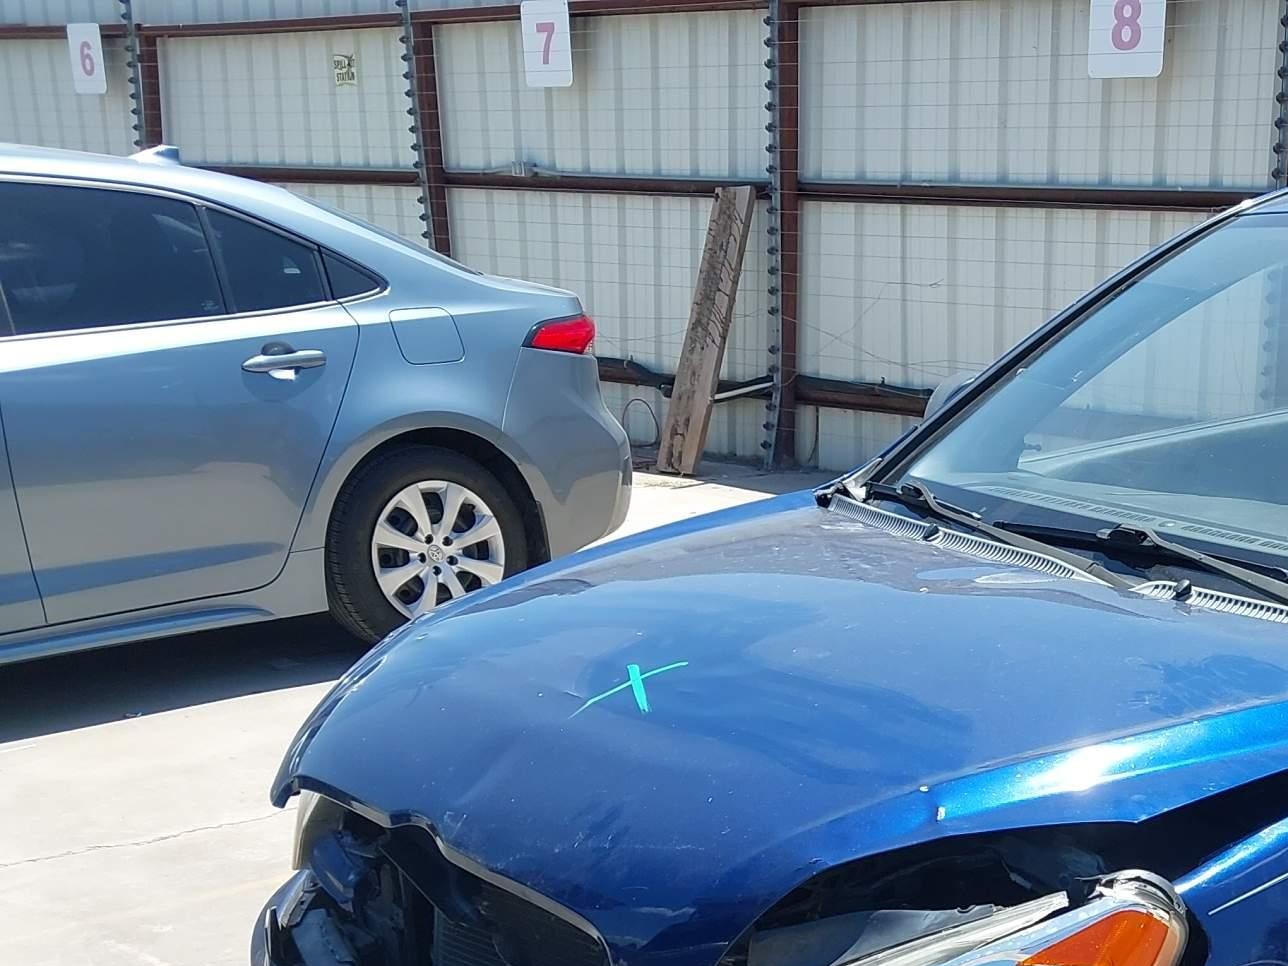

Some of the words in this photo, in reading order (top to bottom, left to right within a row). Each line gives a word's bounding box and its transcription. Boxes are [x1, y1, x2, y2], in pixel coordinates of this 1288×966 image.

[536, 22, 555, 64] 7
[1112, 0, 1141, 50] 8
[80, 41, 94, 76] 6
